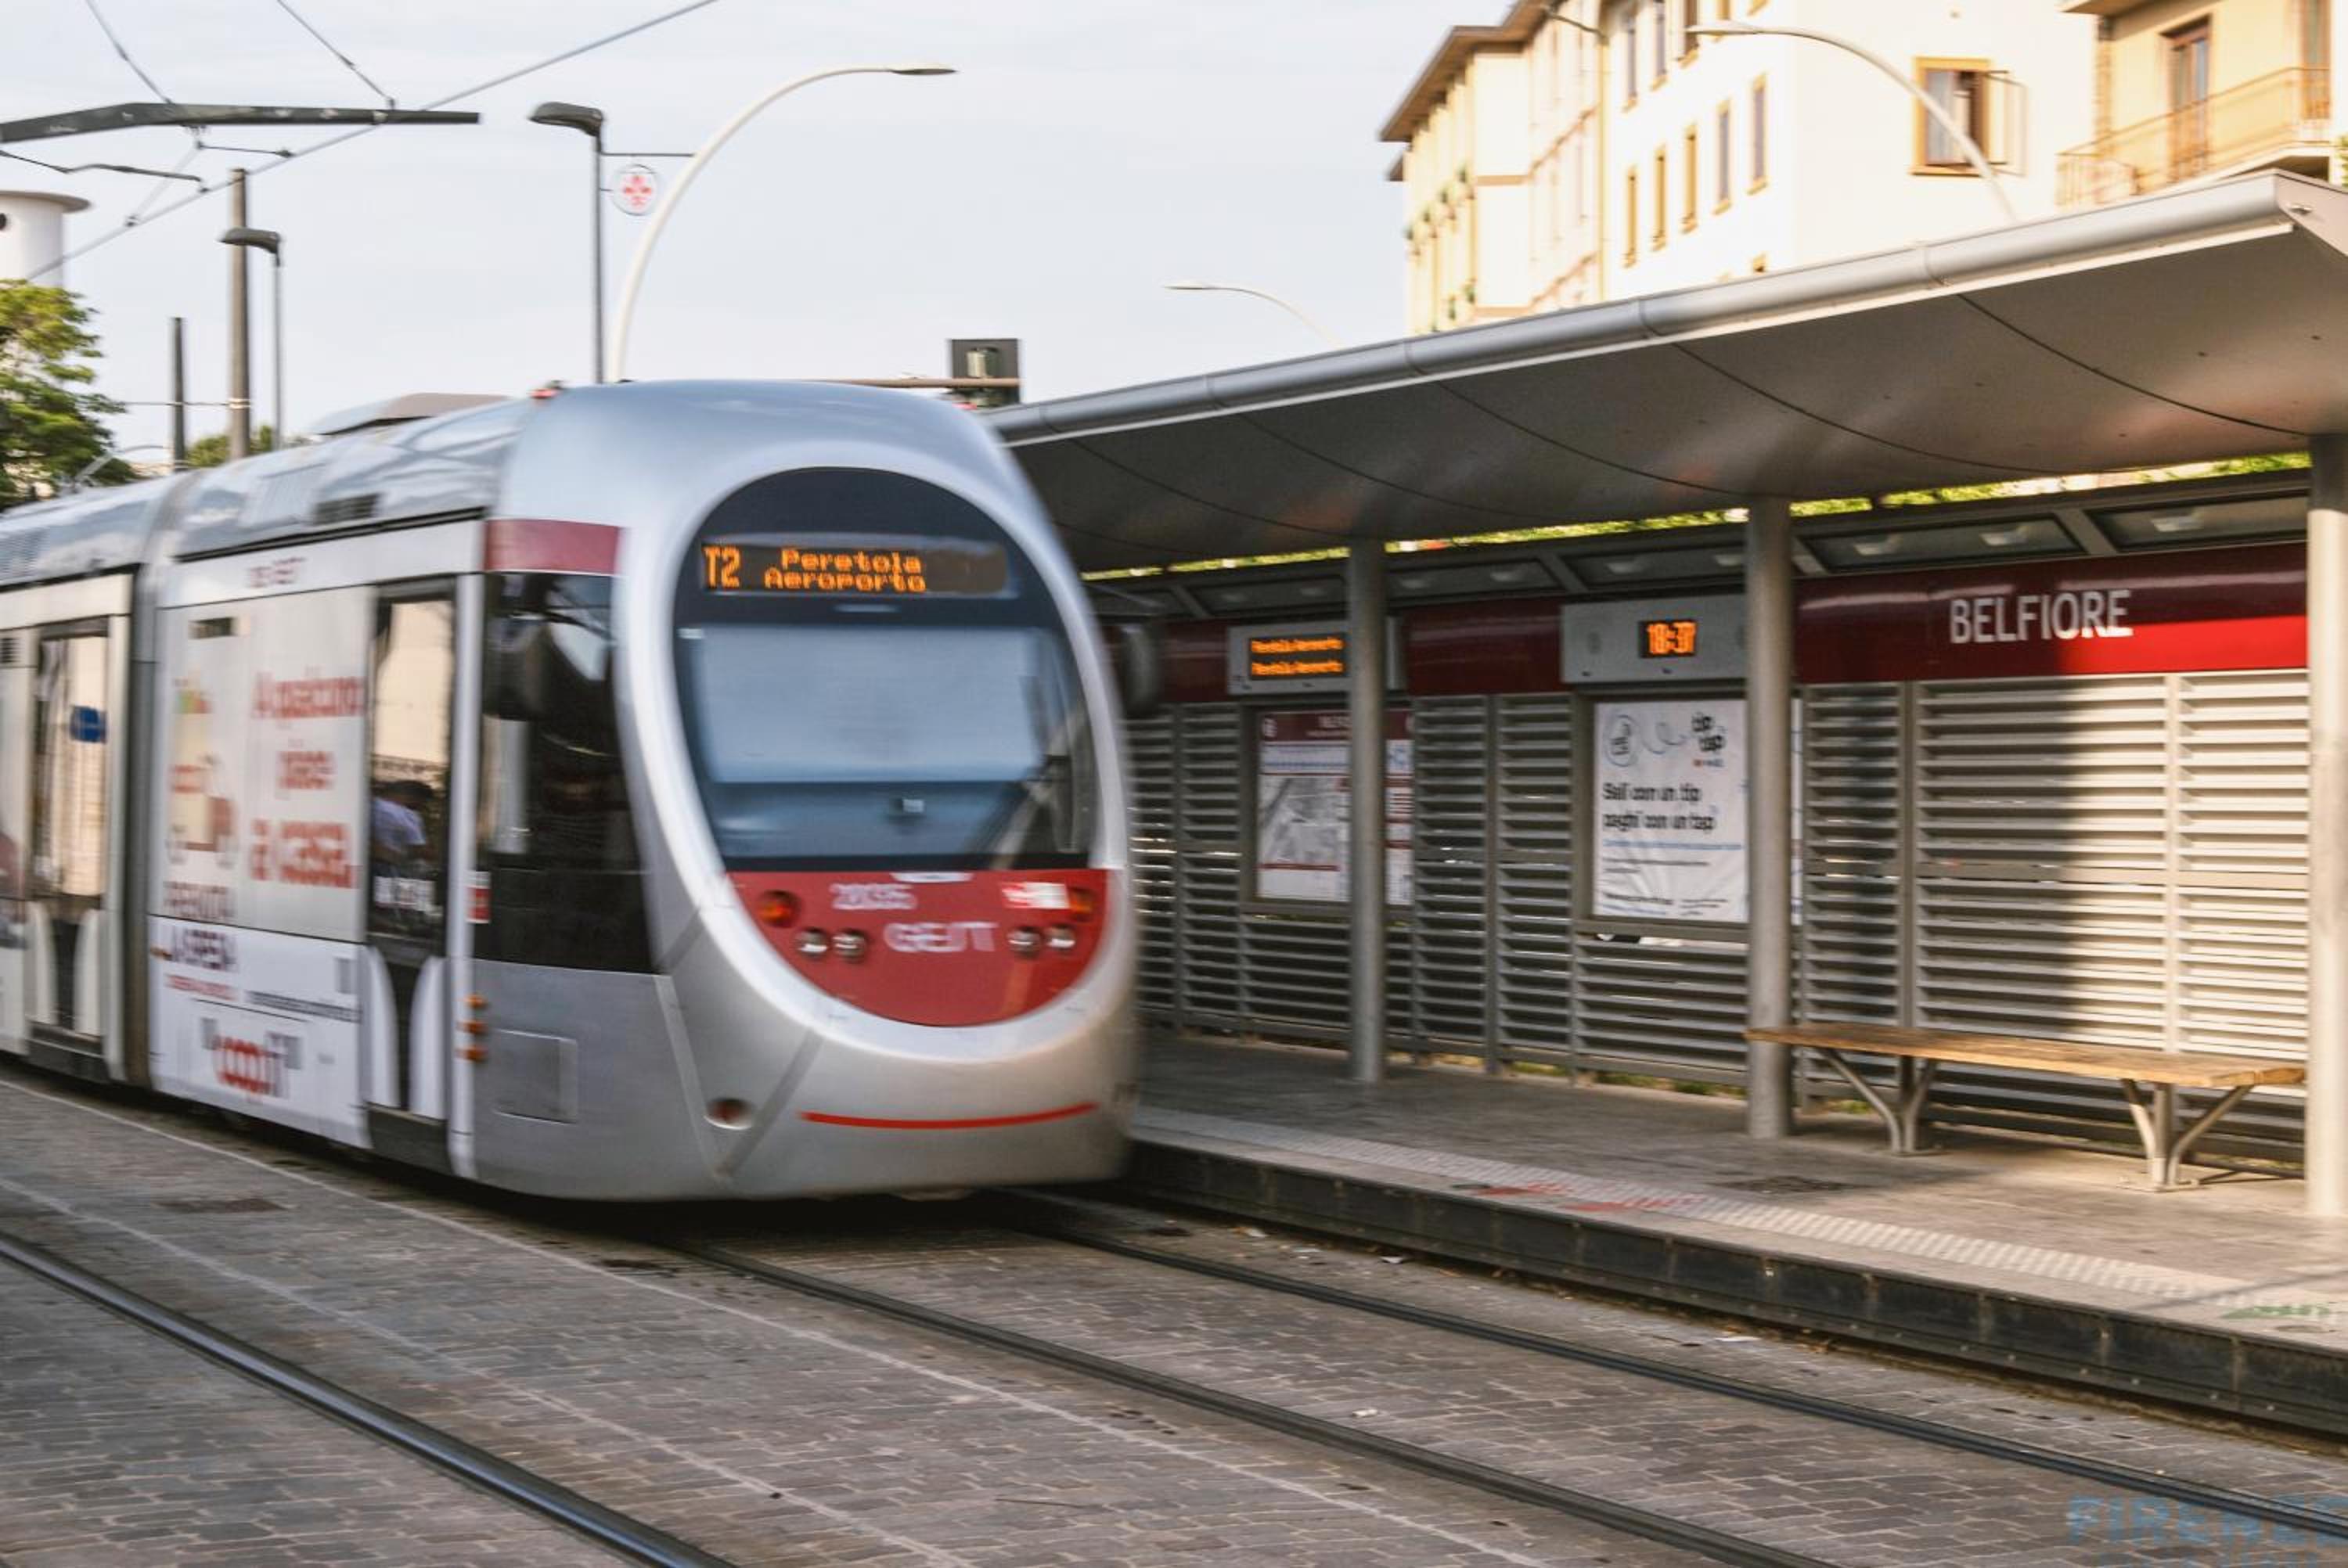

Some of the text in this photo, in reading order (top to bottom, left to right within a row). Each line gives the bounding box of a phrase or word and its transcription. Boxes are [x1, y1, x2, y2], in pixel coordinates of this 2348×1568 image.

[704, 545, 741, 588] T2
[781, 548, 922, 574] Peretola
[764, 567, 927, 593] Aeroporto
[1950, 588, 2134, 643] BELFIORE
